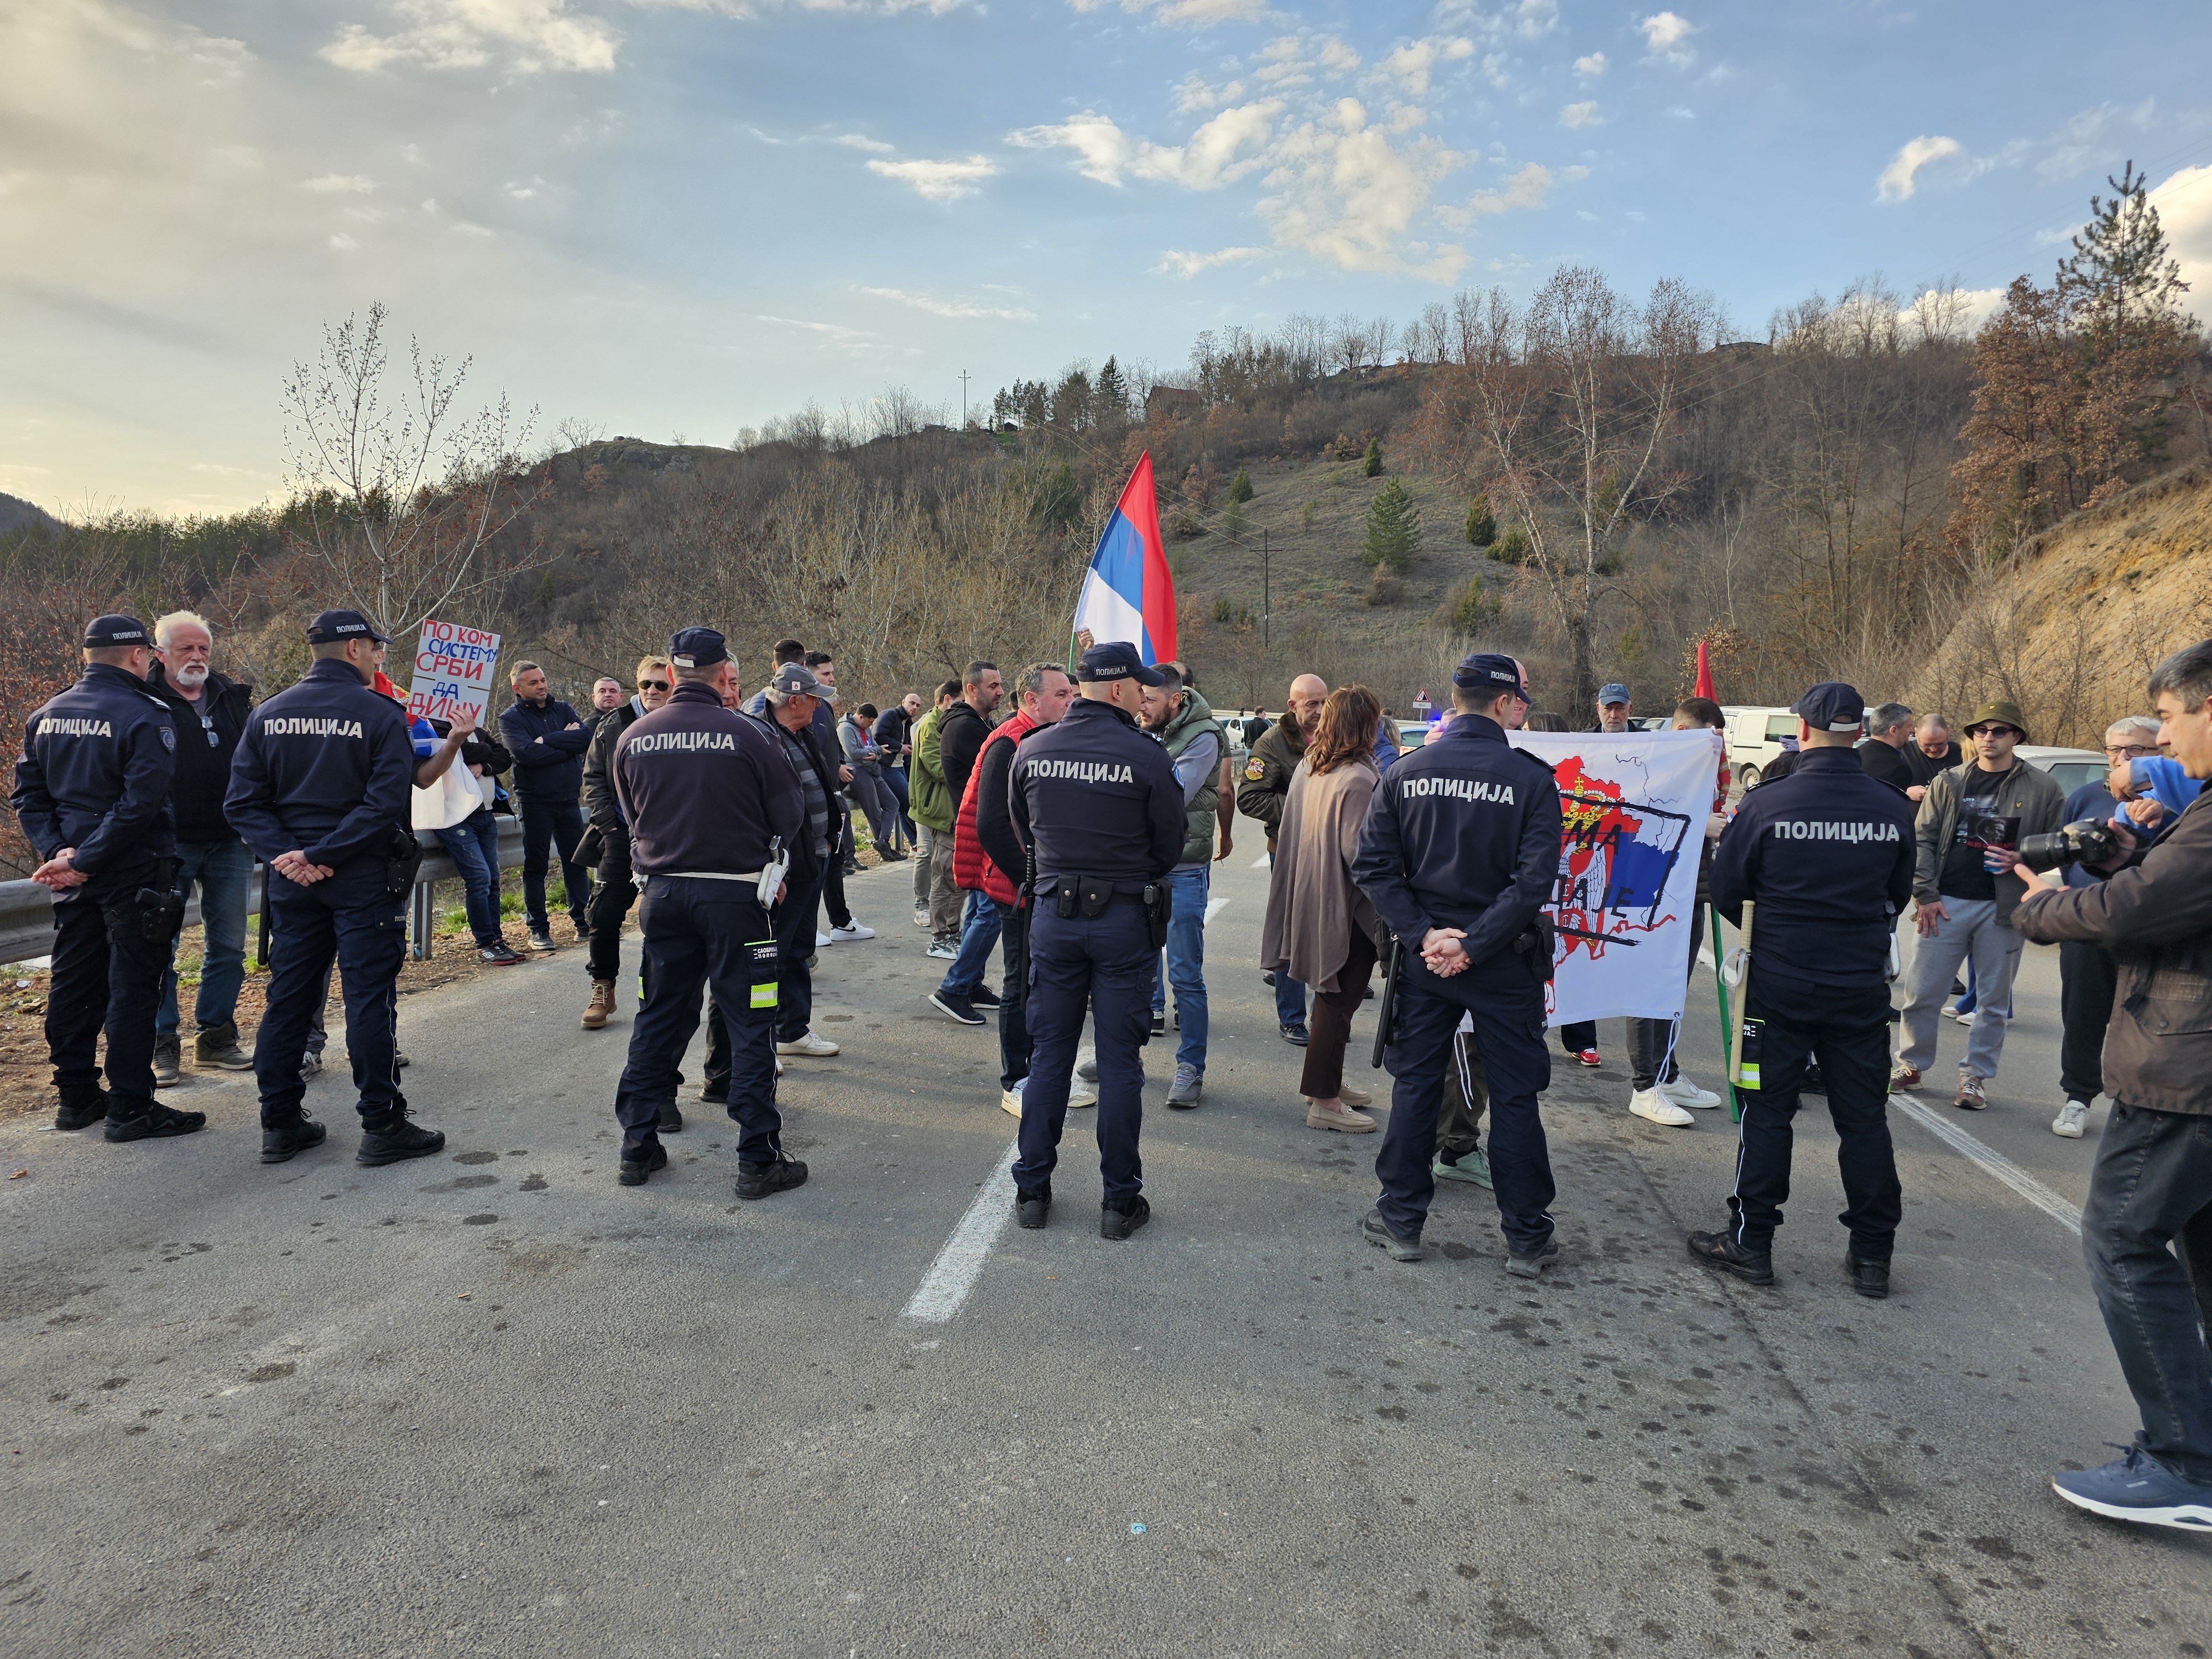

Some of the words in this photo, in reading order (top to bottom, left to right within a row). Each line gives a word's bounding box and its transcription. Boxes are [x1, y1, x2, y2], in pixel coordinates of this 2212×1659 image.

[112, 630, 142, 640] ПОЛИЦИЈА
[336, 624, 367, 633] ПОЛИЦИЈА
[422, 620, 452, 641] ПО
[457, 627, 493, 648] КОМ
[428, 639, 498, 662] СИСТЕМУ
[416, 652, 483, 681] СРБИ
[1095, 666, 1127, 676] ПОЛИЦИЈА
[432, 682, 458, 700] ДА
[36, 718, 111, 737] ПОЛИЦИЈА
[264, 718, 362, 738] ПОЛИЦИЈА
[630, 732, 735, 754] ПОЛИЦИЈА
[1027, 759, 1133, 784] ПОЛИЦИЈА
[1404, 778, 1514, 805] ПОЛИЦИЈА
[1775, 821, 1900, 844] ПОЛИЦИЈА
